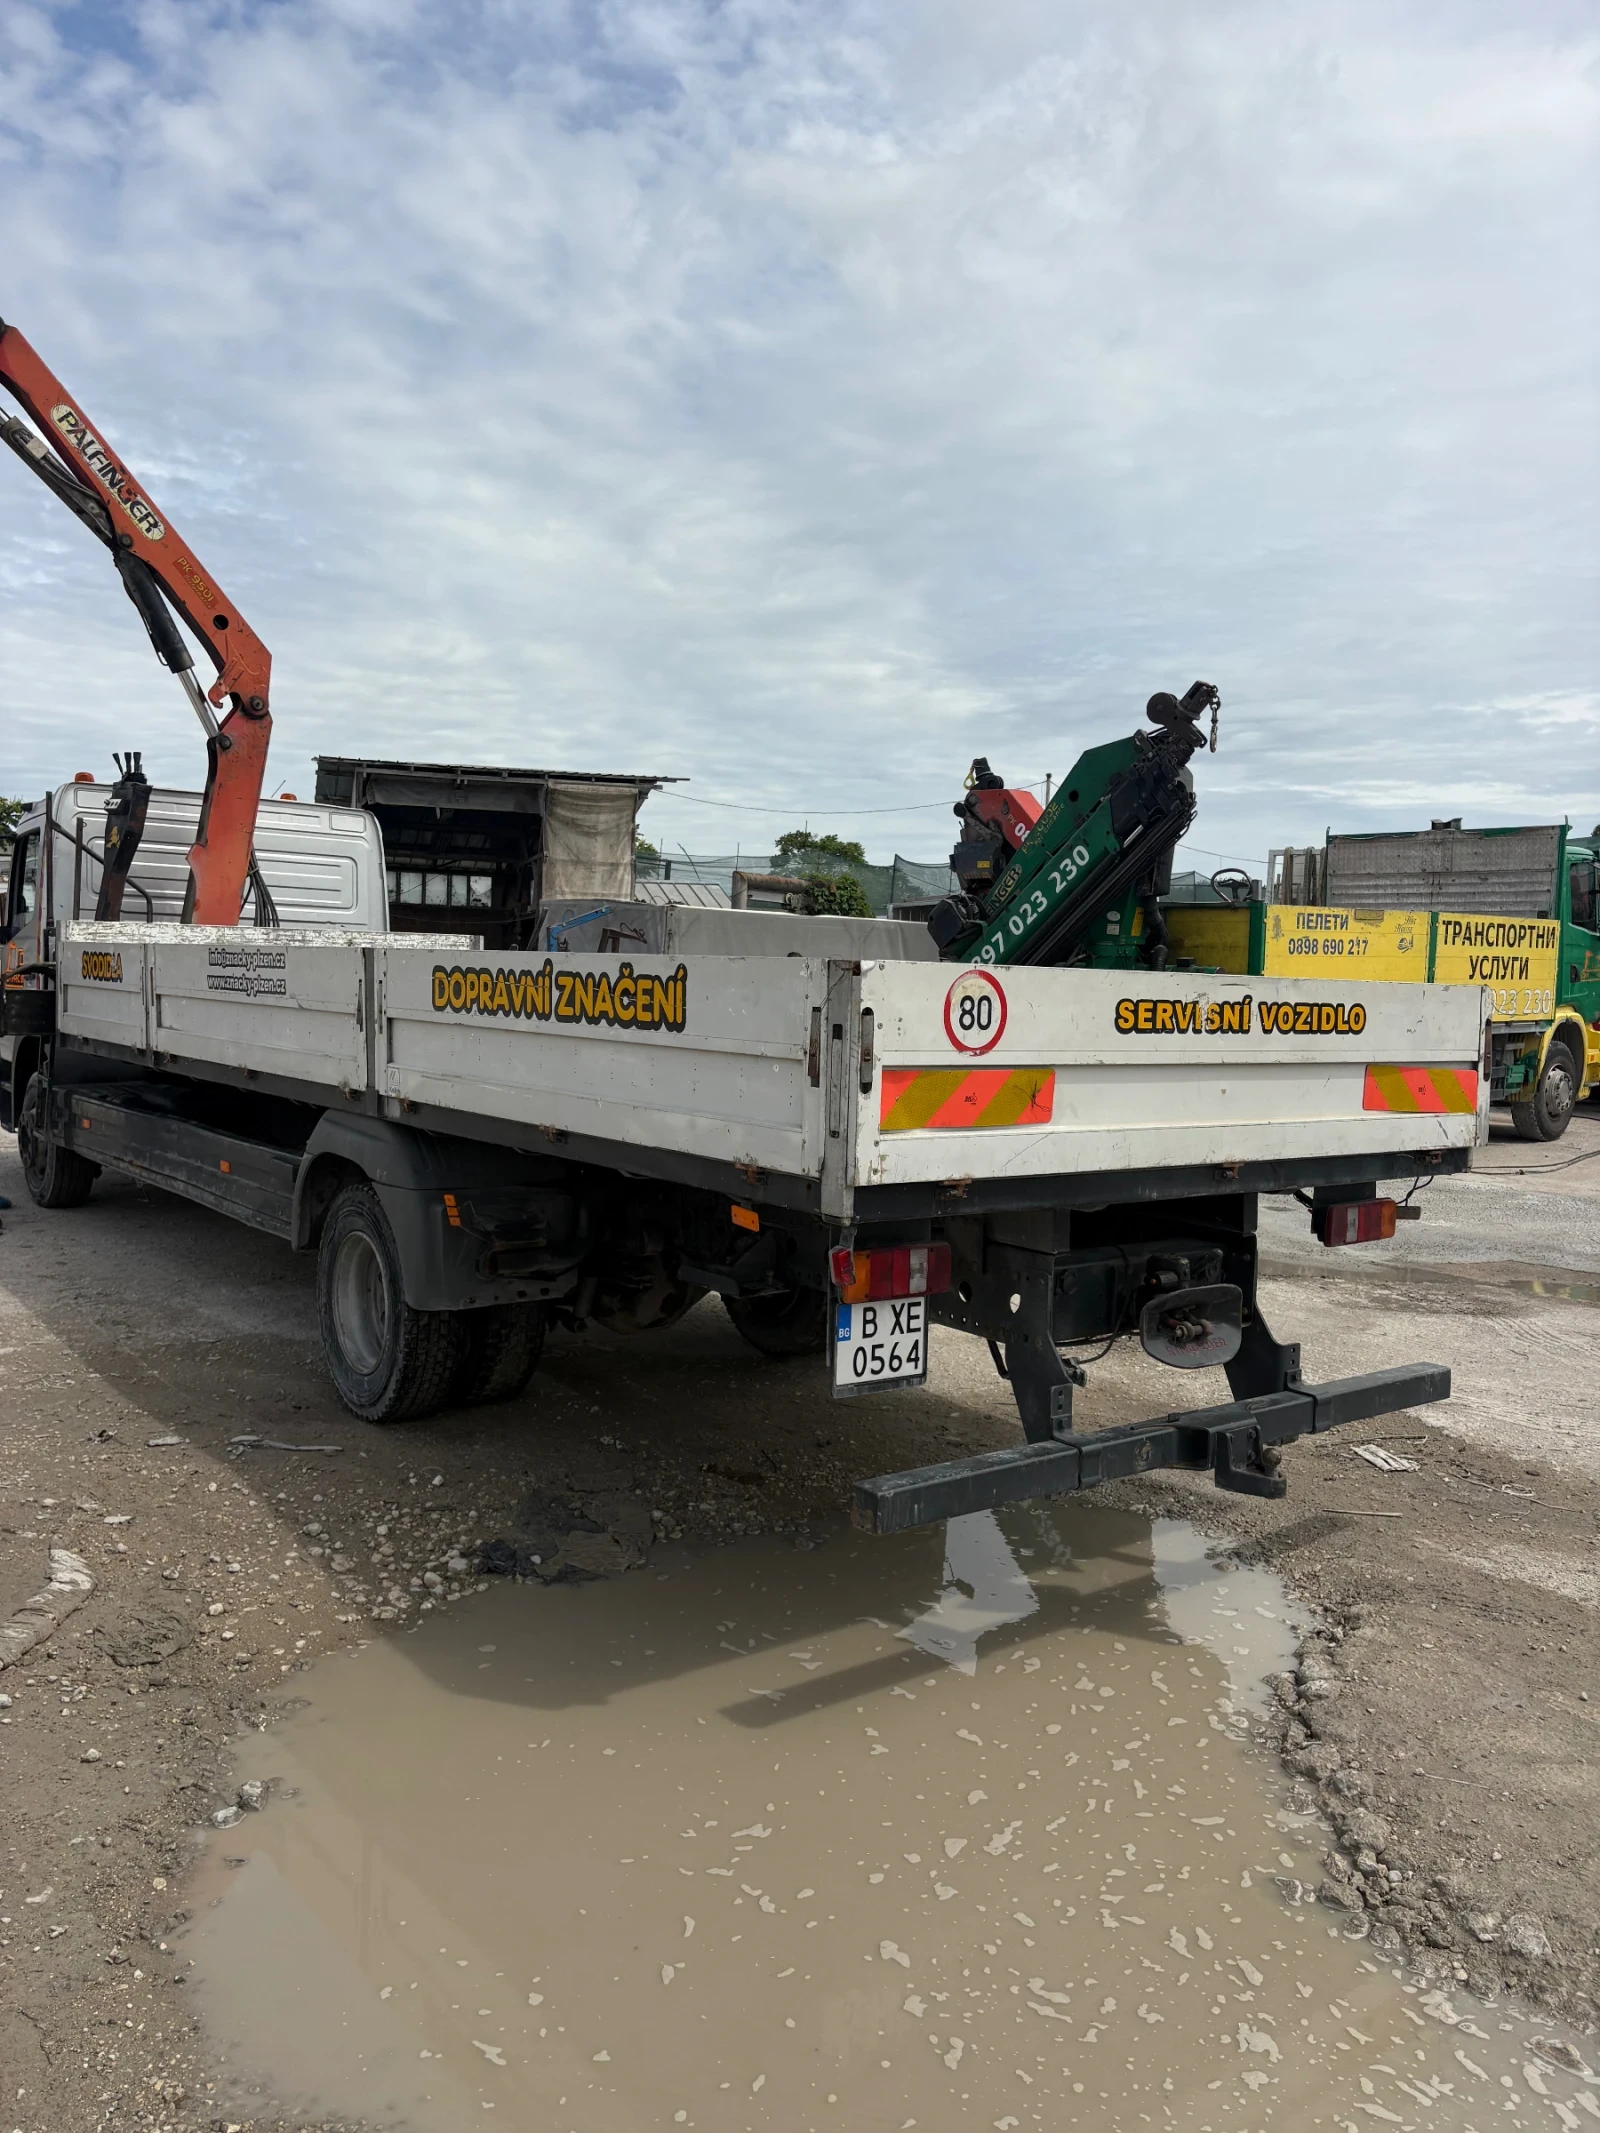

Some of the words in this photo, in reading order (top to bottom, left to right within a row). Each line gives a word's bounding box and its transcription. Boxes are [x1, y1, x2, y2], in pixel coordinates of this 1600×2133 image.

[57, 410, 162, 534] PALFINGER
[1008, 890, 1048, 936] 023
[1048, 845, 1090, 894] 230
[1296, 912, 1349, 931] ПЕЛЕТИ
[1442, 920, 1556, 949] ТРАНСПОРТНИ
[209, 947, 286, 971] info@znacky-plzen.cz
[1288, 937, 1319, 955] 0898
[1322, 938, 1344, 955] 690
[1468, 955, 1530, 980] УСЛУГИ
[207, 973, 287, 997] www.znacky-plzen.cz
[433, 960, 552, 1020] DOPRAVNÍ
[555, 963, 686, 1031] ZNAČENÍ
[958, 995, 993, 1031] 80
[1116, 995, 1252, 1034] SERVISNÍ
[1258, 1002, 1366, 1034] VOZIDLO
[1523, 989, 1551, 1015] 230
[838, 1328, 850, 1338] BG
[862, 1306, 878, 1339] B
[890, 1301, 921, 1336] XE
[853, 1339, 920, 1377] 0564
